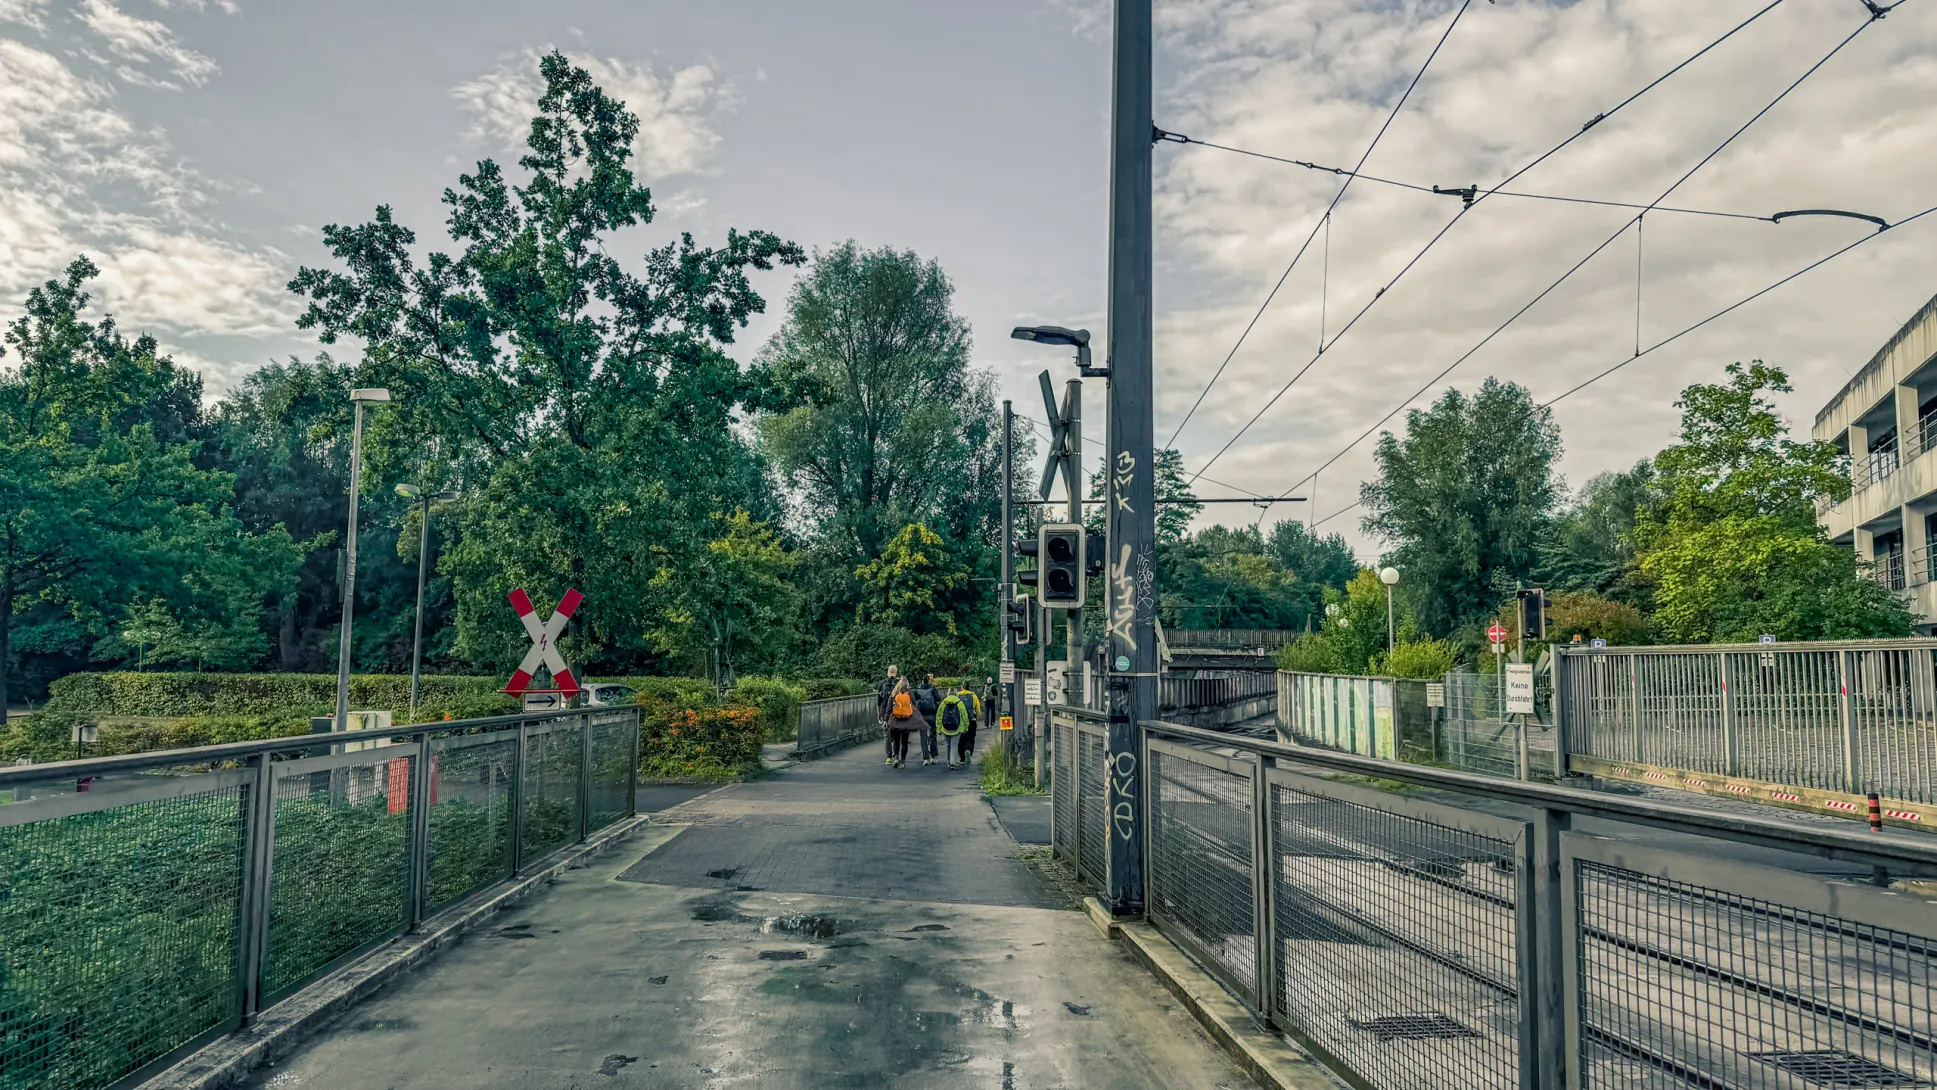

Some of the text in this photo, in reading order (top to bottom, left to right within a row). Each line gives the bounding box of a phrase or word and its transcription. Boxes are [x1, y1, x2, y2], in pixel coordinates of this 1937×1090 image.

[1594, 640, 1603, 648] P
[1510, 681, 1529, 689] Keine
[1507, 694, 1533, 703] Durchfahrt
